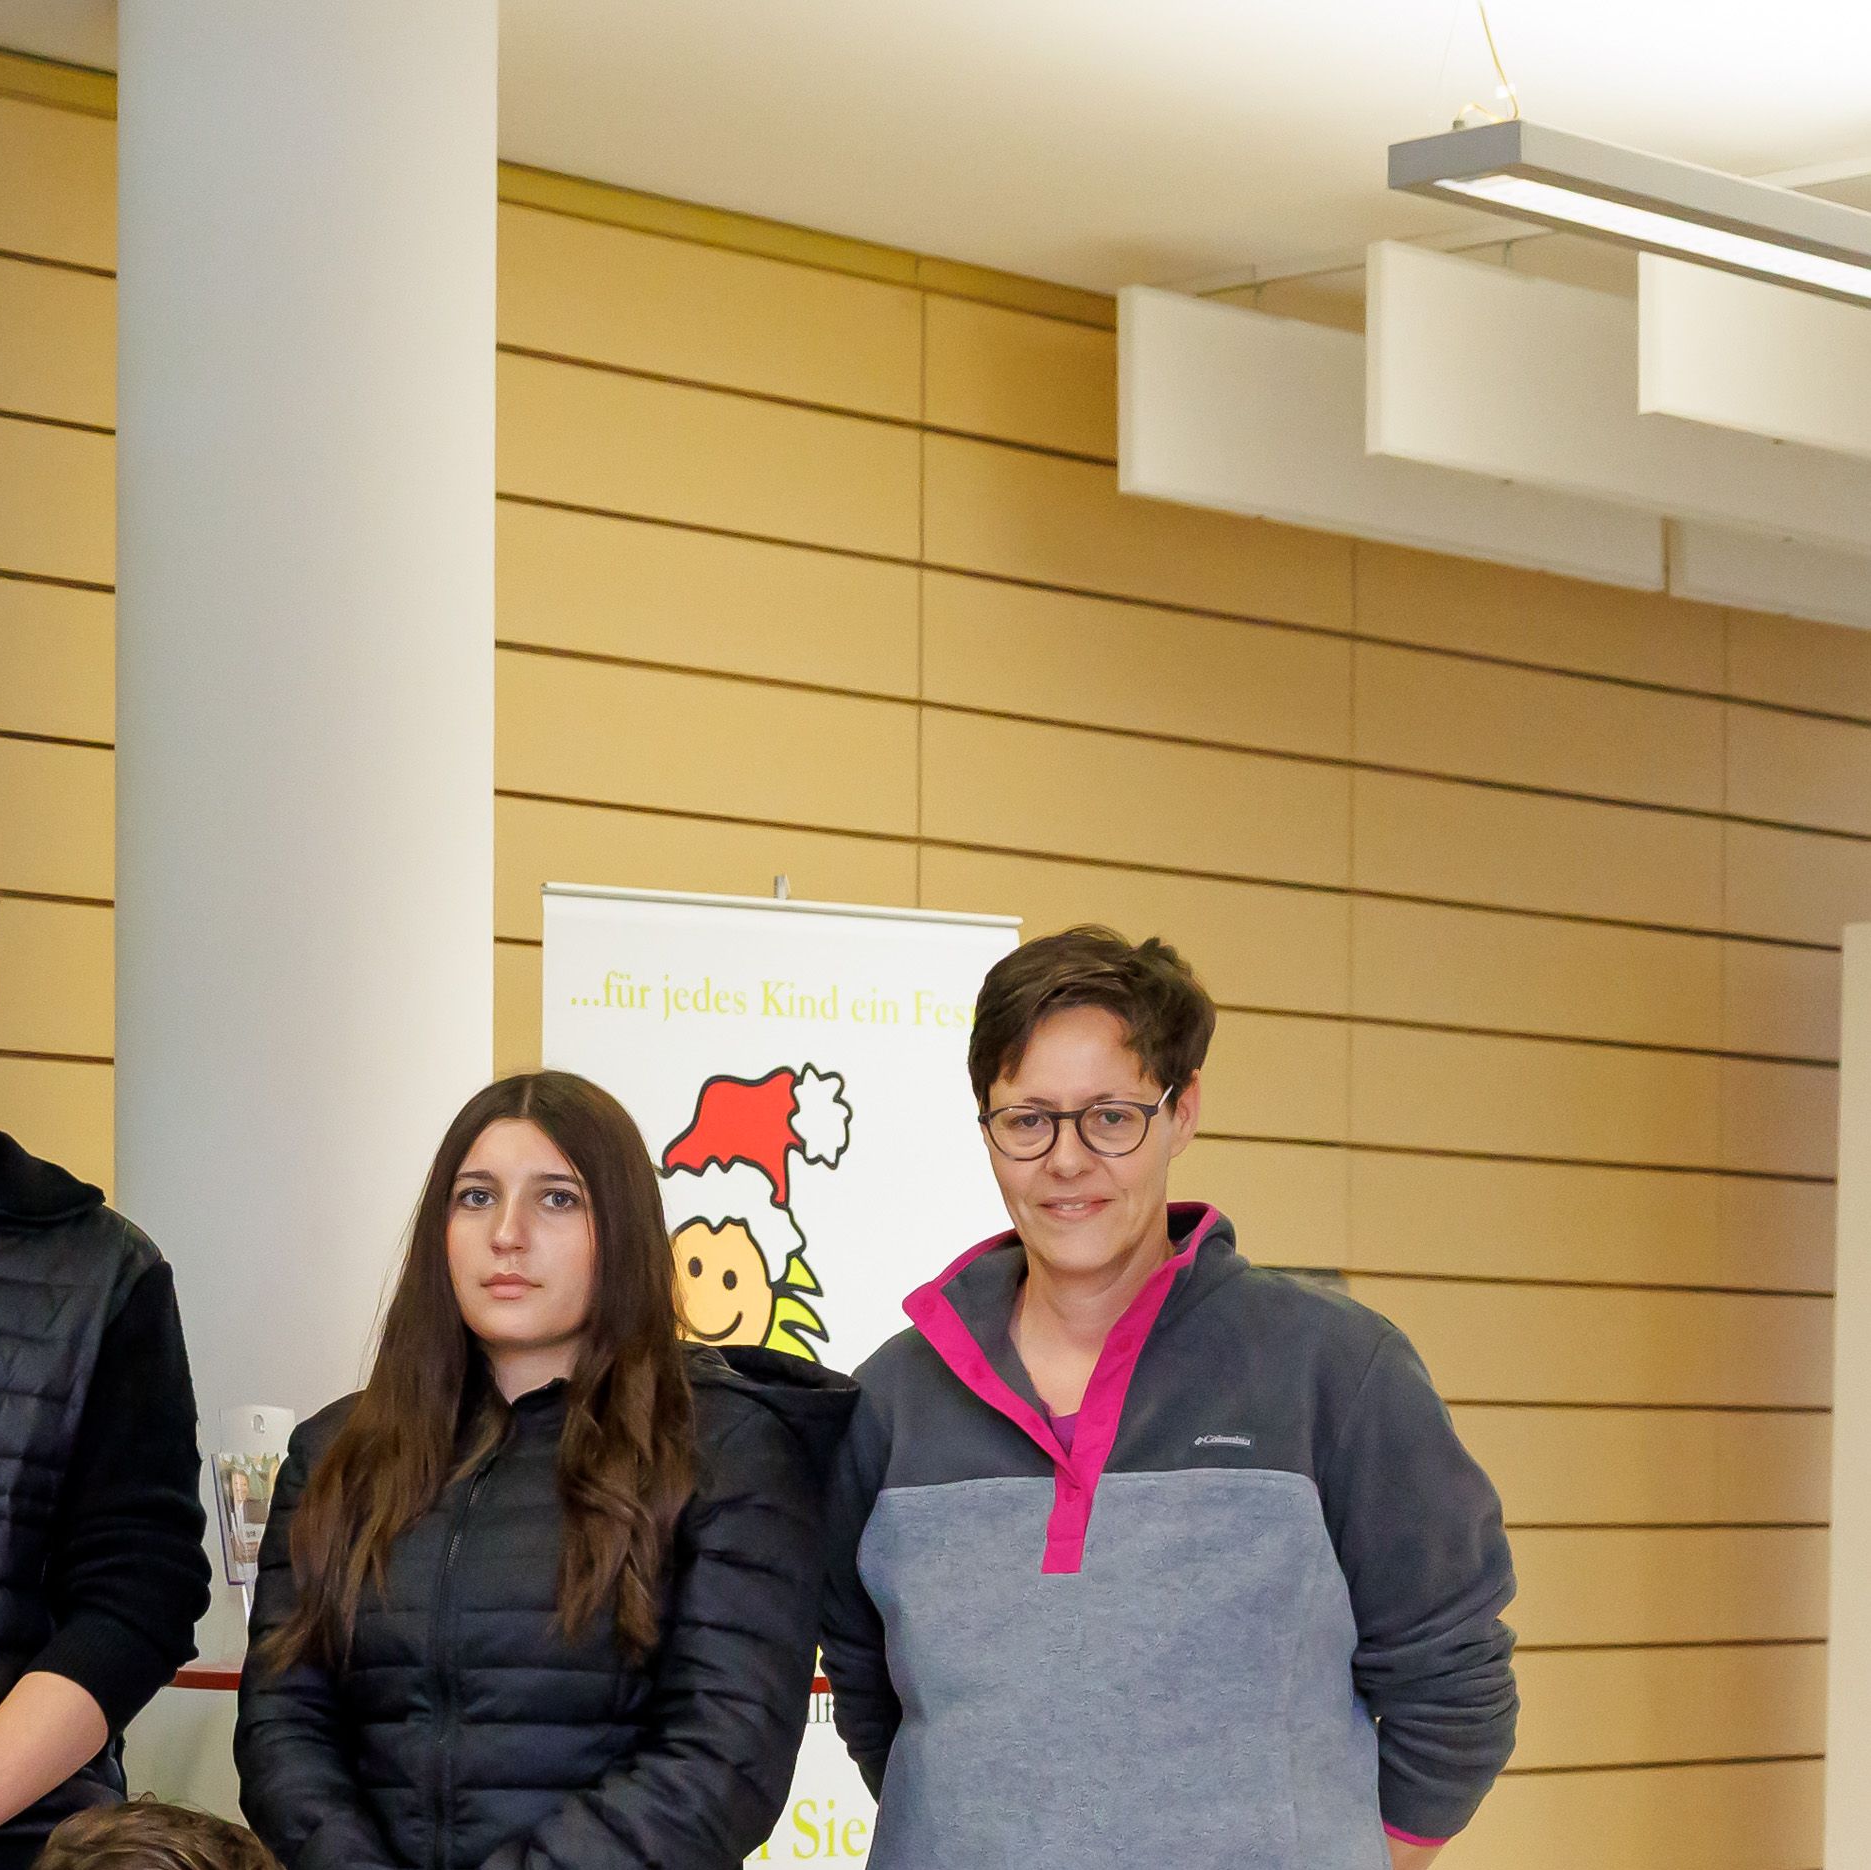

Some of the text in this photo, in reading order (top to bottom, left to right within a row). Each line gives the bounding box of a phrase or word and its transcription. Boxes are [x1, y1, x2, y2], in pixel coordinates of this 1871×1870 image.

[663, 974, 748, 1022] jedes
[761, 979, 839, 1022] Kind
[850, 986, 900, 1025] ein
[792, 1798, 867, 1859] Sie
